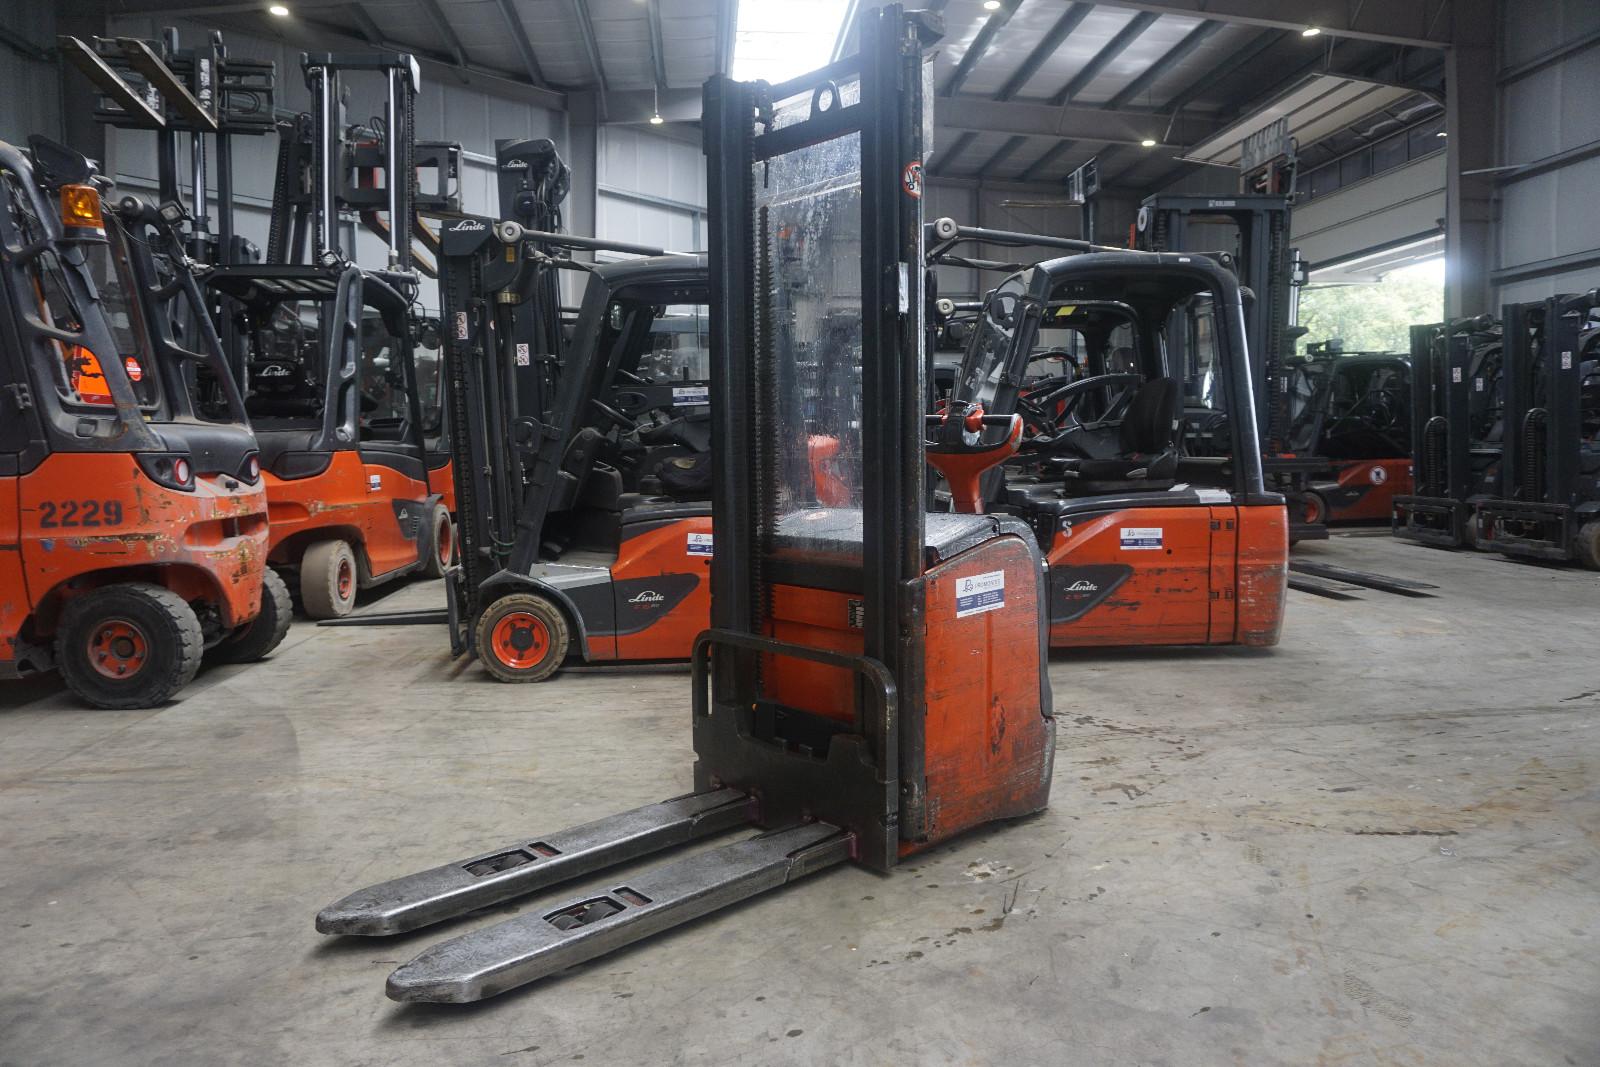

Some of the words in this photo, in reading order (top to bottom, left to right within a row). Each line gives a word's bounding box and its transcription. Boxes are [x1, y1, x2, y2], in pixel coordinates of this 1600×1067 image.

[448, 219, 486, 231] Linde
[39, 500, 123, 528] 2229
[1064, 580, 1098, 591] Linde
[628, 590, 665, 602] Linde
